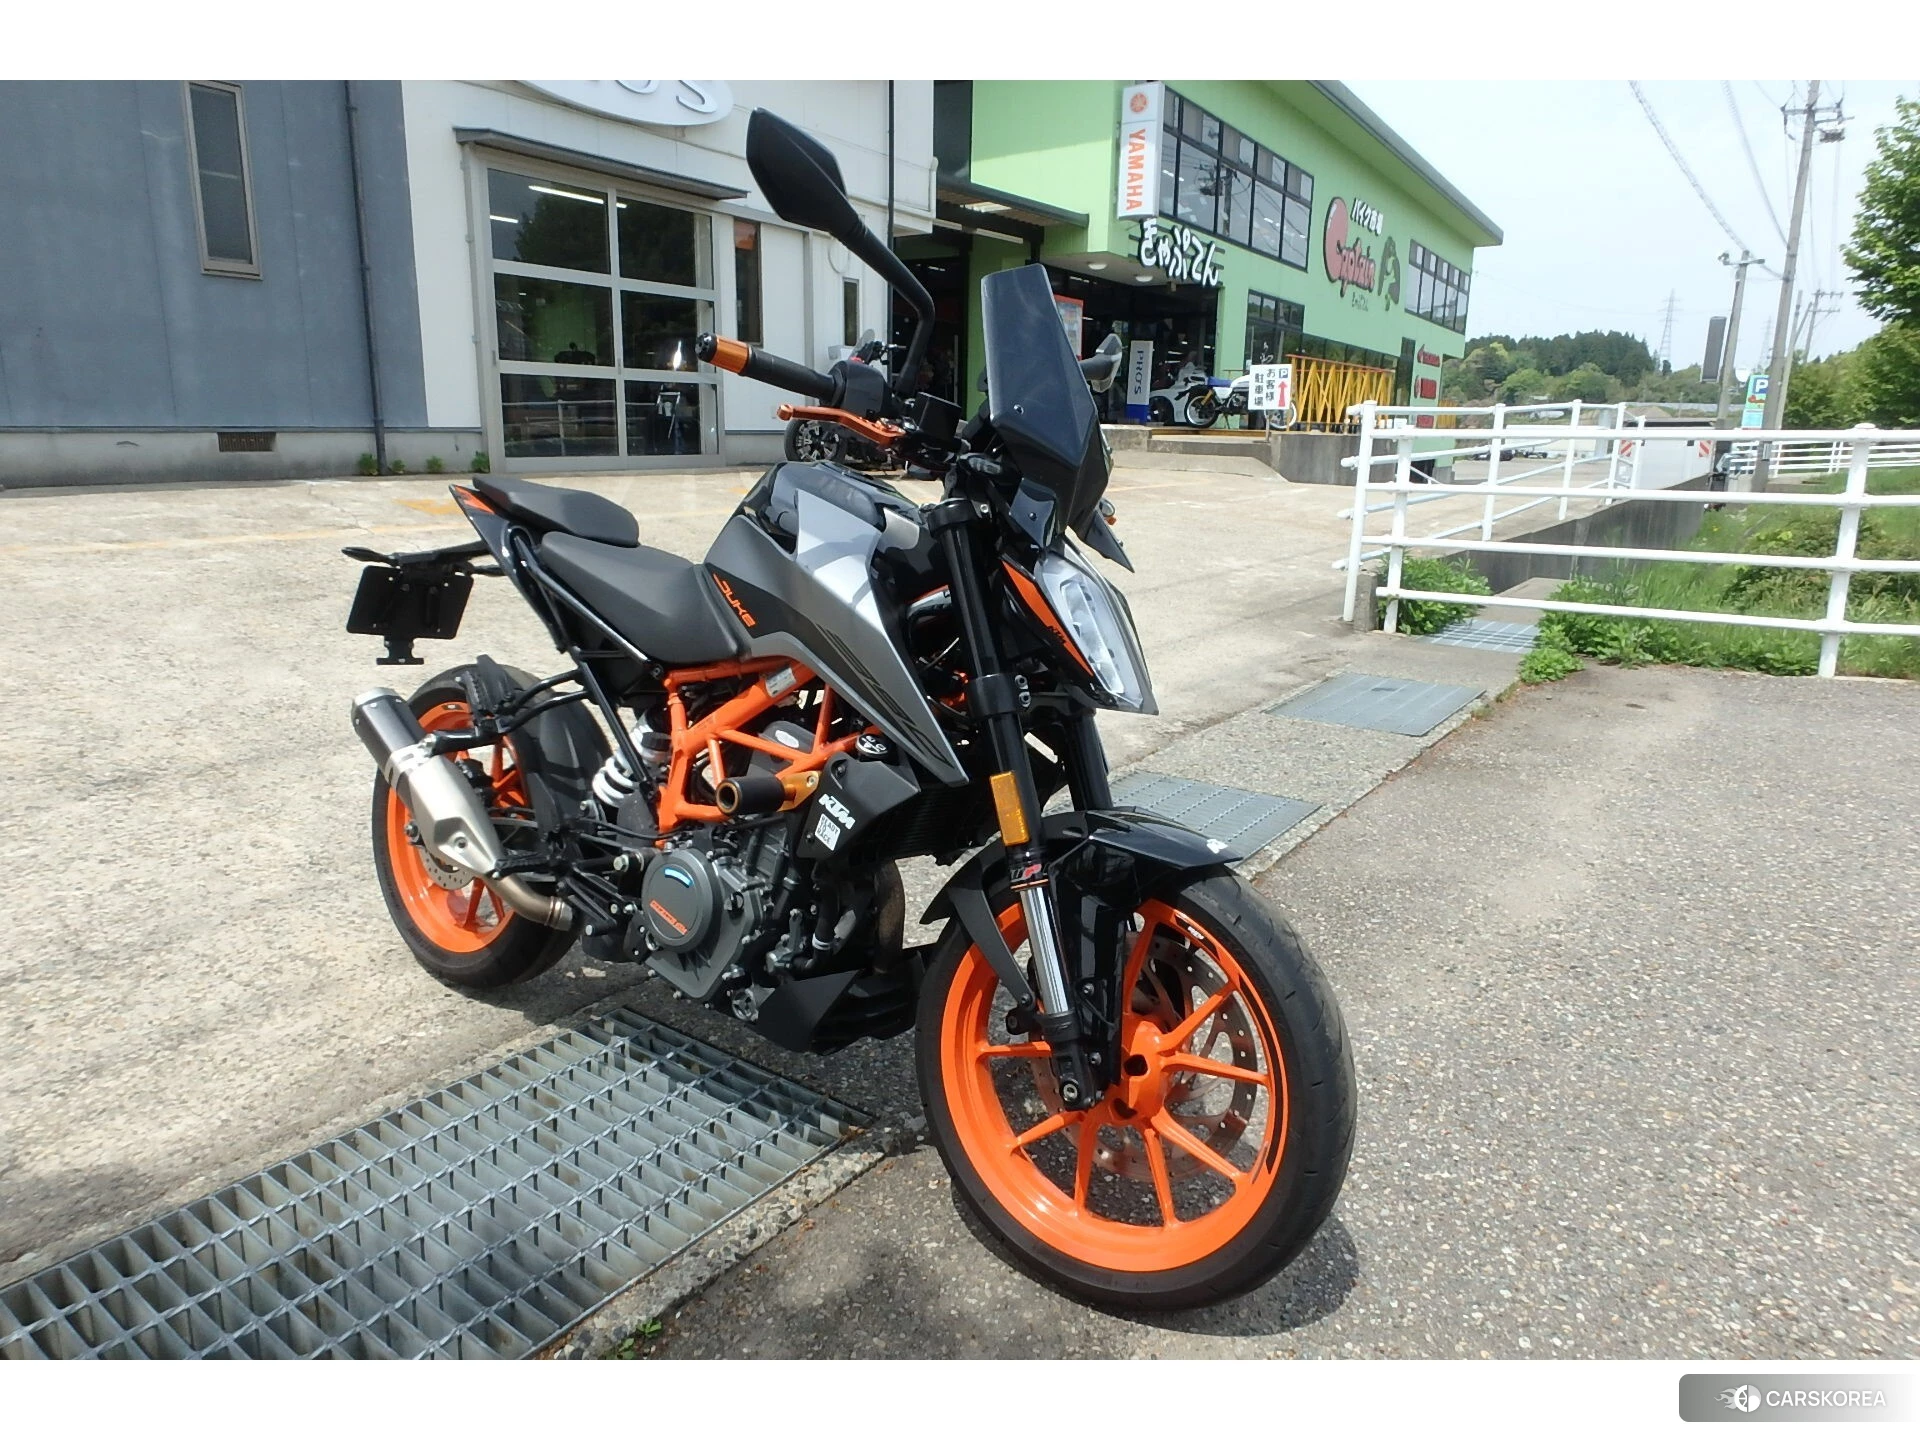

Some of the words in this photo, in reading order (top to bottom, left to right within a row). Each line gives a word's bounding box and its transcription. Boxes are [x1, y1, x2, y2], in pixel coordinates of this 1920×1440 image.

[1126, 128, 1146, 211] YAMAHA
[1140, 217, 1219, 287] きゃぷてん
[1323, 196, 1376, 298] Captain
[1755, 379, 1769, 393] P
[713, 573, 756, 627] DUKE
[819, 793, 856, 830] KTM
